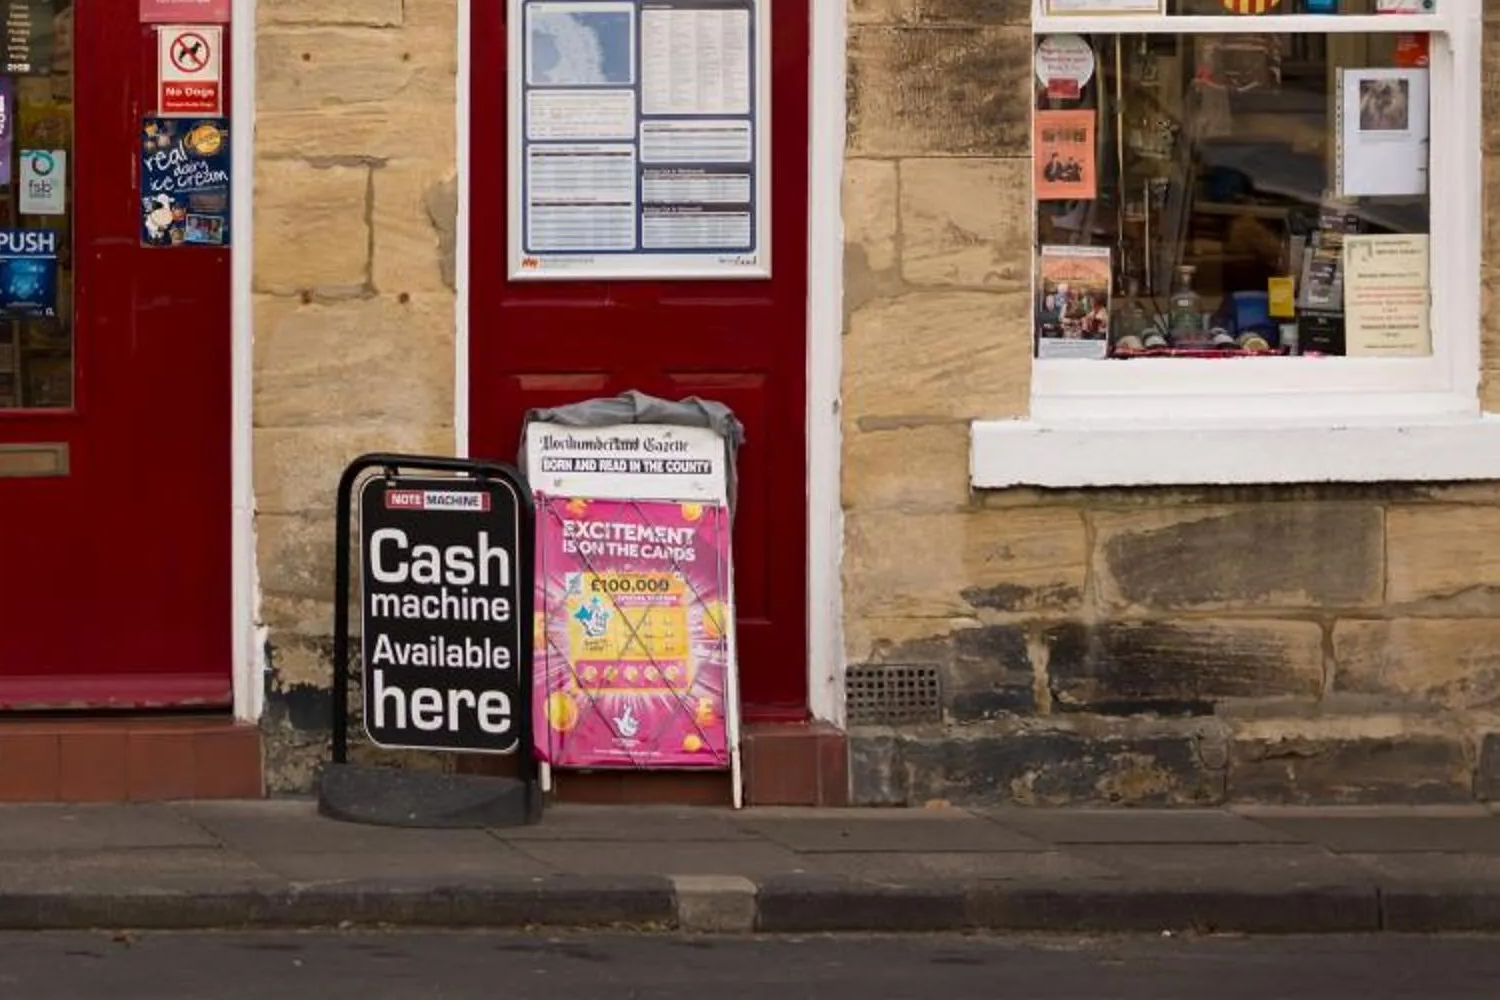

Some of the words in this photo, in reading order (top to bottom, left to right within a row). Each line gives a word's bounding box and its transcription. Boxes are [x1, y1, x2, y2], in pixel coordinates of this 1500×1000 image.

[164, 87, 183, 97] No
[185, 87, 215, 99] Dogs
[144, 139, 188, 172] real
[150, 176, 175, 191] ice
[178, 169, 229, 187] cream
[540, 434, 640, 452] Northumberland
[643, 436, 689, 453] Gazette
[543, 458, 573, 472] BORN
[574, 458, 596, 472] AND
[599, 458, 628, 473] READ
[630, 459, 642, 473] IN
[644, 459, 664, 473] THE
[666, 460, 711, 474] COUNTY
[426, 493, 481, 508] MACHINE
[563, 518, 696, 546] EXCITEMENT
[369, 527, 510, 587] Cash
[563, 539, 577, 553] IS
[579, 540, 605, 557] ON
[606, 541, 638, 558] THE
[370, 586, 511, 622] machine
[372, 632, 511, 669] Available
[373, 668, 512, 734] here
